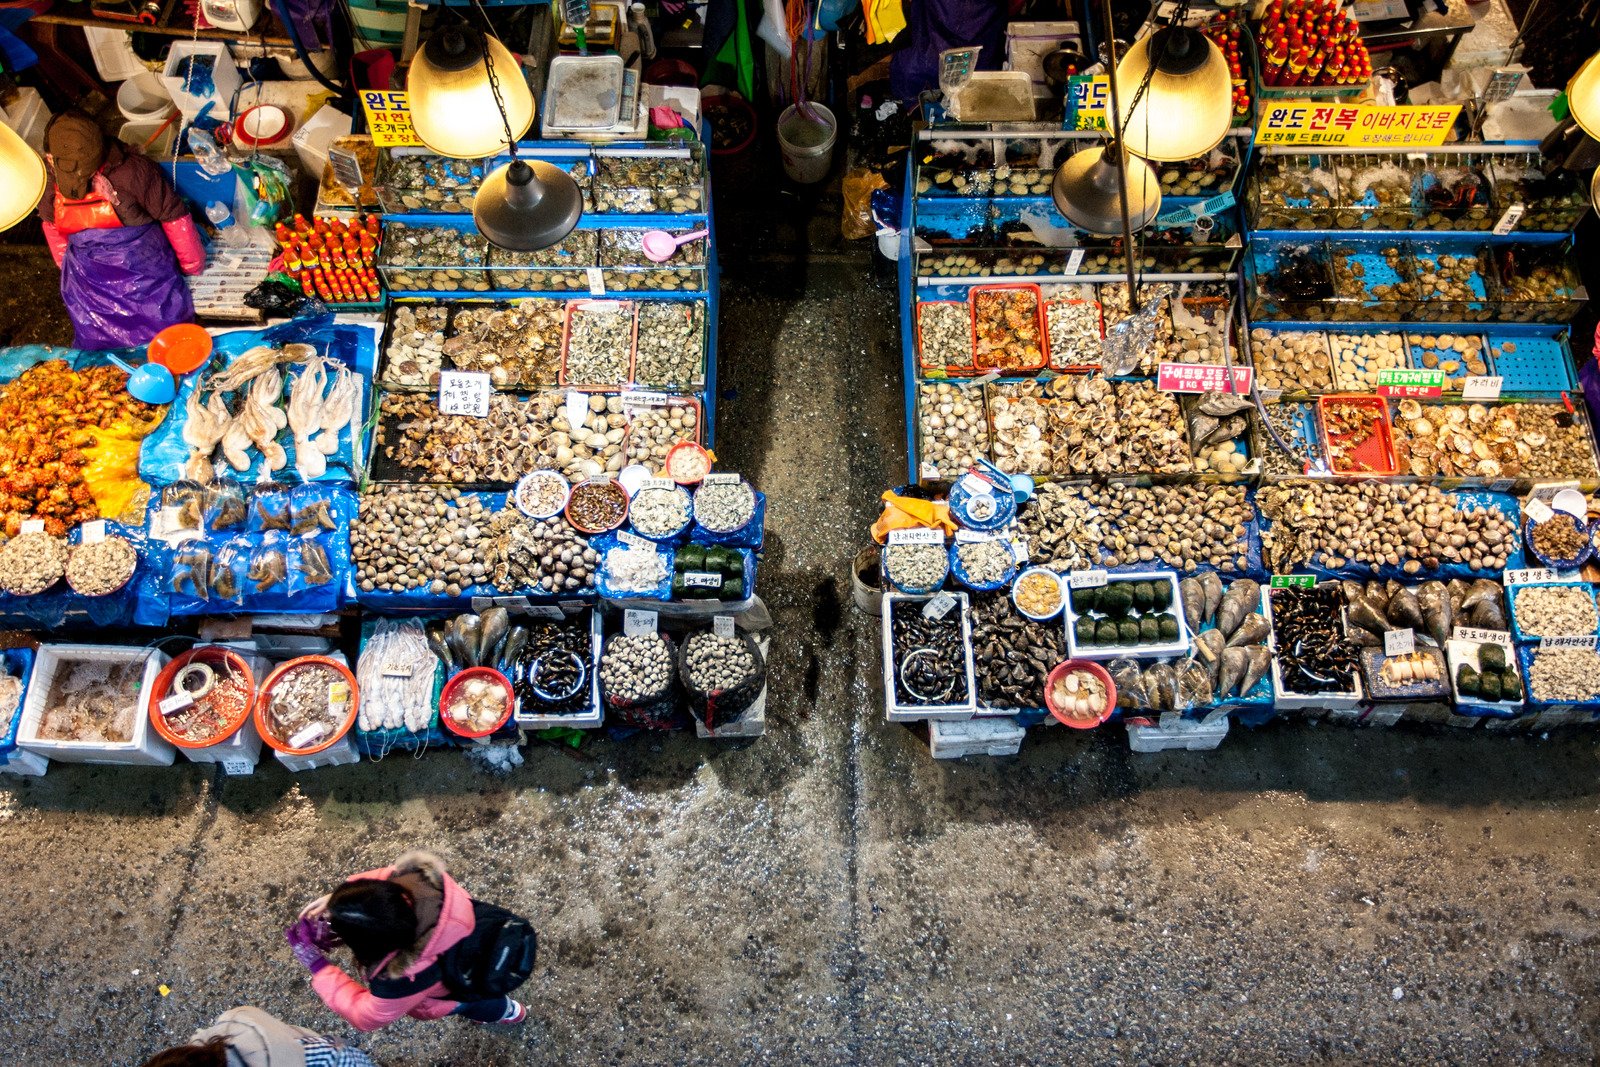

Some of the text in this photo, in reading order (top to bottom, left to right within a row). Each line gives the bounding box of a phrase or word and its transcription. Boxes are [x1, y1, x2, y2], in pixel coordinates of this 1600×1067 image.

[365, 92, 410, 111] 완도
[1073, 83, 1107, 109] 완도
[374, 112, 411, 122] 자연
[1268, 108, 1451, 130] 완도 전복 이바지 전문
[1470, 379, 1499, 388] 가리비
